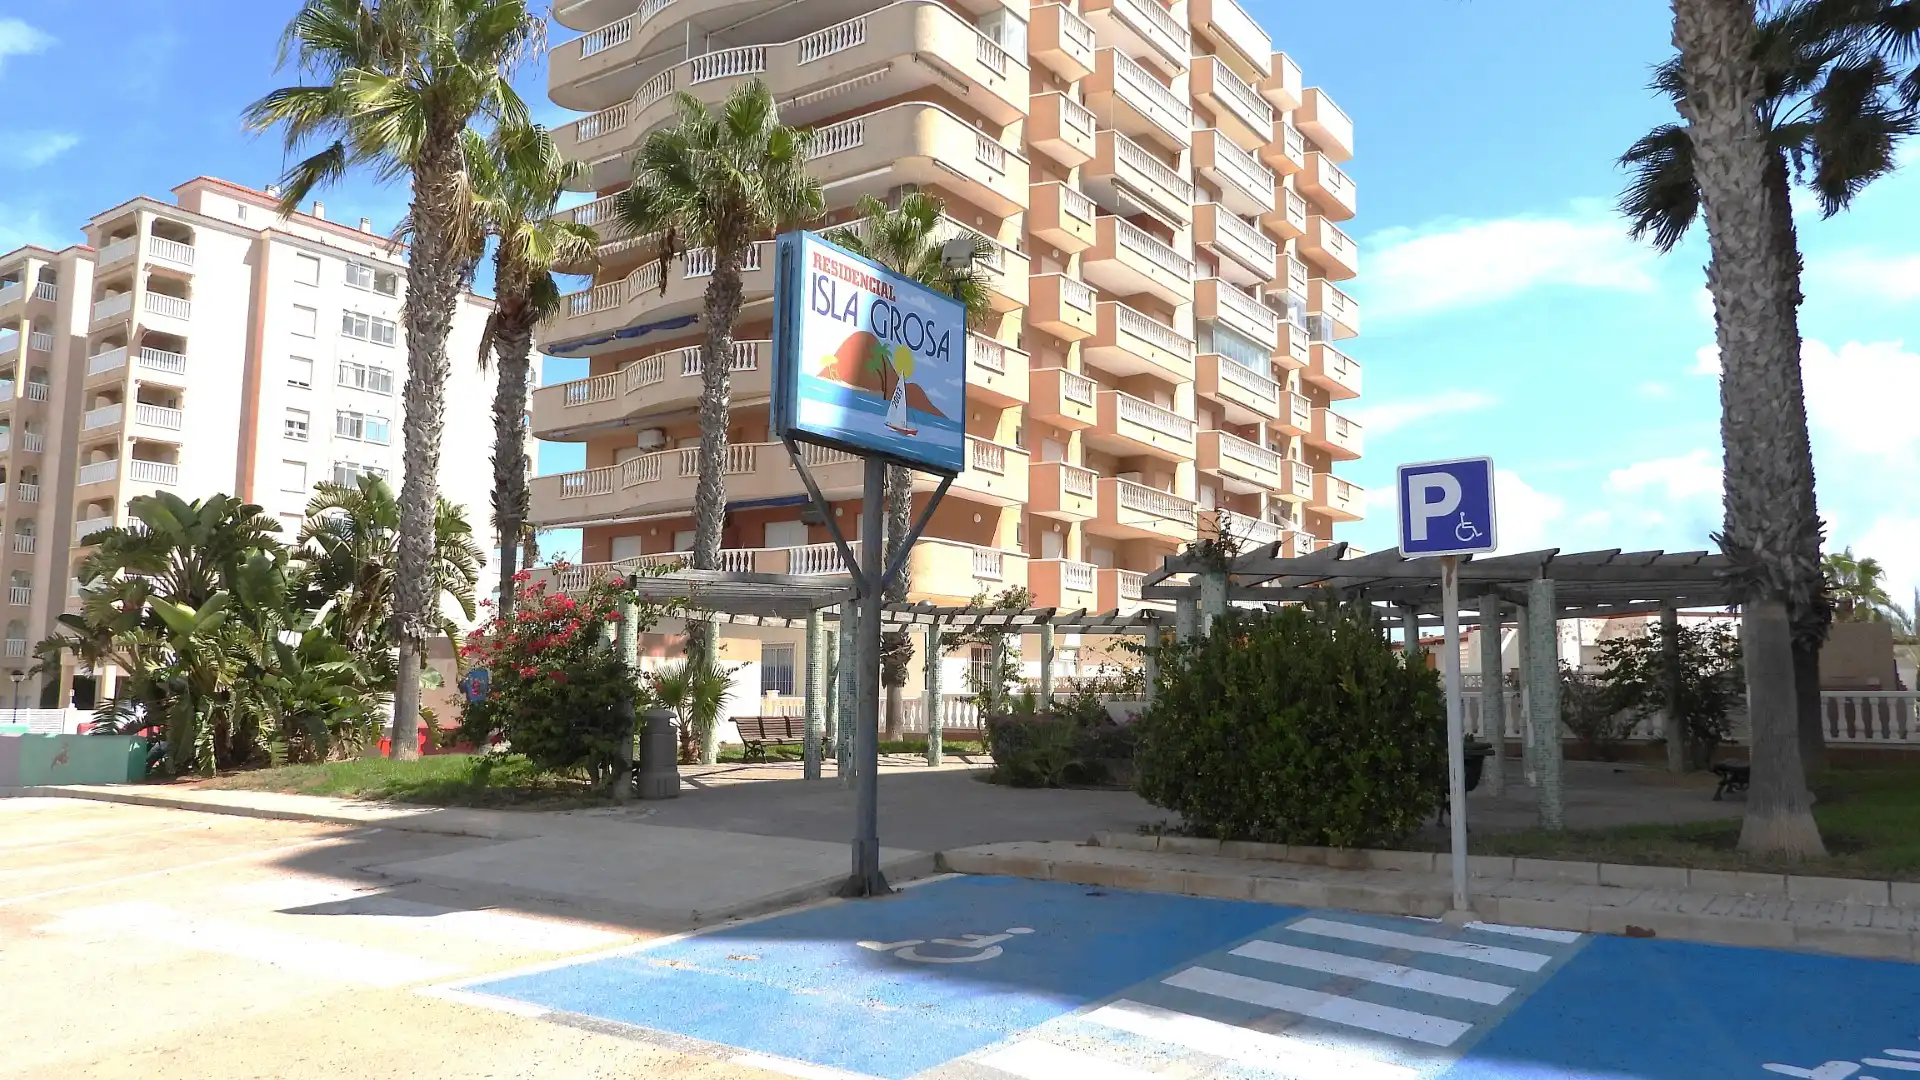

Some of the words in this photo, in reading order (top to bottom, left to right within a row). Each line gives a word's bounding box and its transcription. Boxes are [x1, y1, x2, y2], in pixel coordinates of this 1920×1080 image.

[812, 251, 896, 302] RESIDENCIAL
[811, 272, 858, 327] ISLA
[870, 299, 950, 362] GROSA
[891, 387, 903, 409] 2003
[1408, 472, 1462, 541] P
